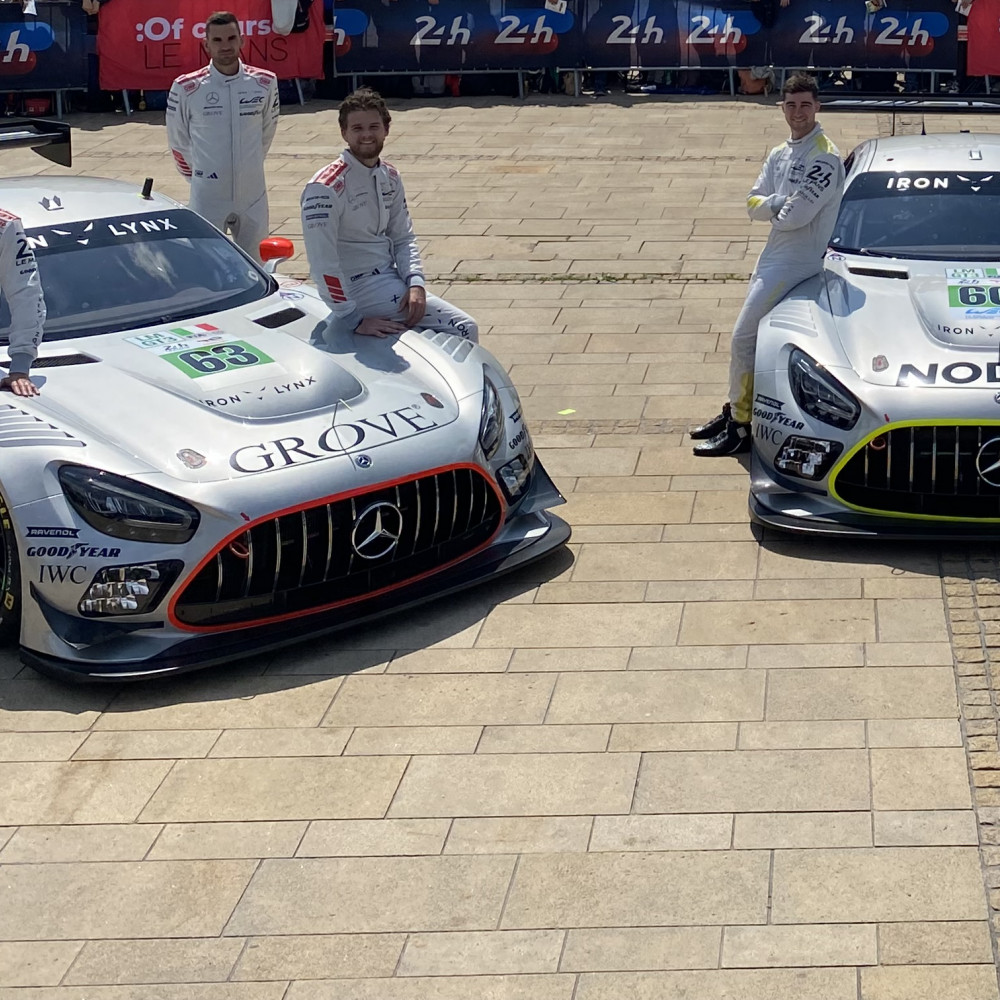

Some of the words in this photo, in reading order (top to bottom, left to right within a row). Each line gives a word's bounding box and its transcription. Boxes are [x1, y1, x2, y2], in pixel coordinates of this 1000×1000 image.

[409, 15, 470, 45] 24h
[494, 14, 554, 44] 24h
[606, 15, 664, 44] 24h
[686, 15, 743, 44] 24h
[798, 15, 855, 44] 24h
[875, 17, 930, 46] 24h
[144, 42, 183, 70] LE
[239, 96, 265, 105] WEC
[886, 177, 949, 190] IRON
[108, 218, 178, 236] LYNX
[141, 336, 178, 346] GT3
[937, 324, 975, 335] IRON
[177, 343, 261, 374] 63
[273, 375, 317, 394] LYNX
[753, 407, 805, 431] GOODYEAR
[756, 423, 783, 446] IWC
[30, 528, 75, 536] RAVENOL
[26, 543, 121, 559] GOODYEAR
[39, 564, 87, 585] IWC
